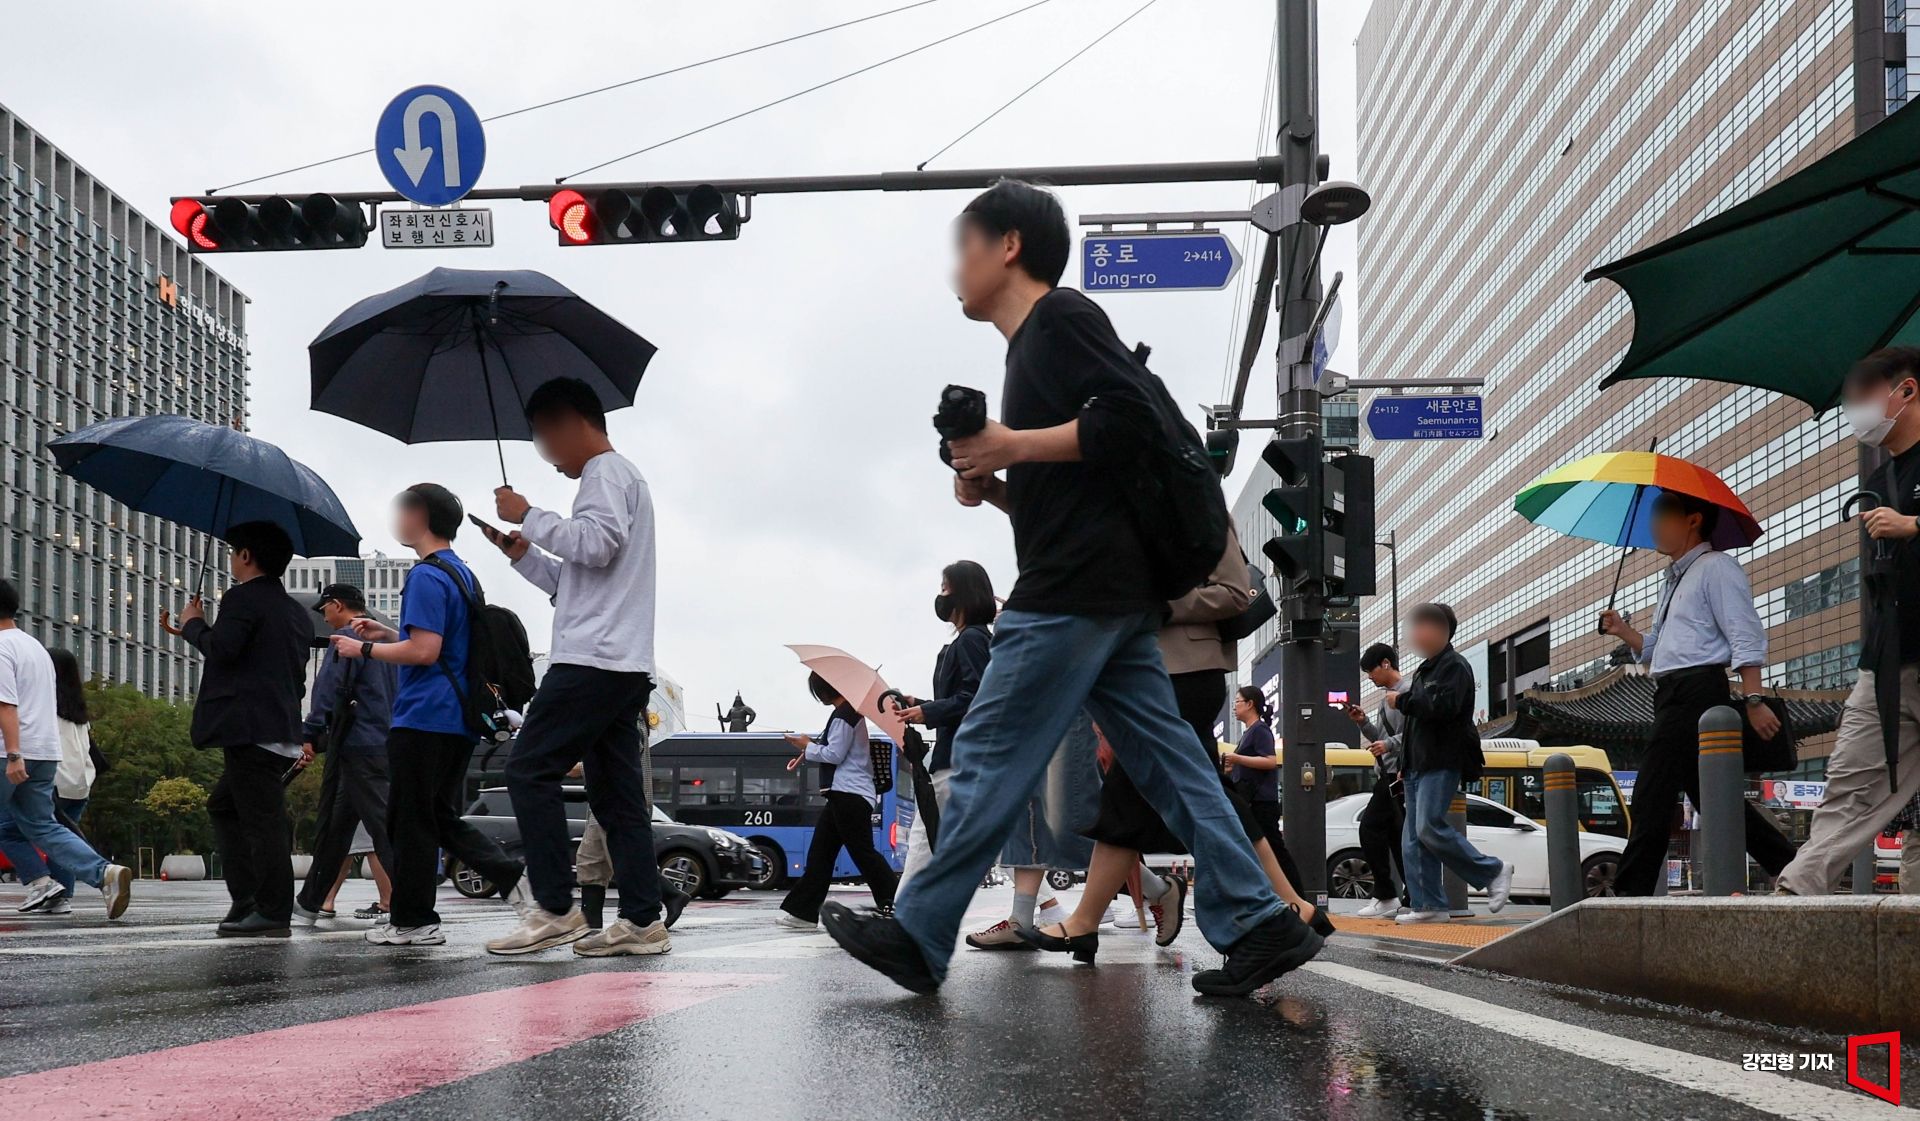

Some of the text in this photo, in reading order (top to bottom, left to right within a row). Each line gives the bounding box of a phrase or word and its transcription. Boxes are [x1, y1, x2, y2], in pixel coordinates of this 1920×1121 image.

[1090, 243, 1138, 267] 종로
[1090, 271, 1157, 288] Jong-ro
[1426, 399, 1478, 414] 새문안로
[1417, 416, 1479, 426] Saemunan-ro
[1521, 775, 1535, 786] 12
[744, 810, 773, 826] 260
